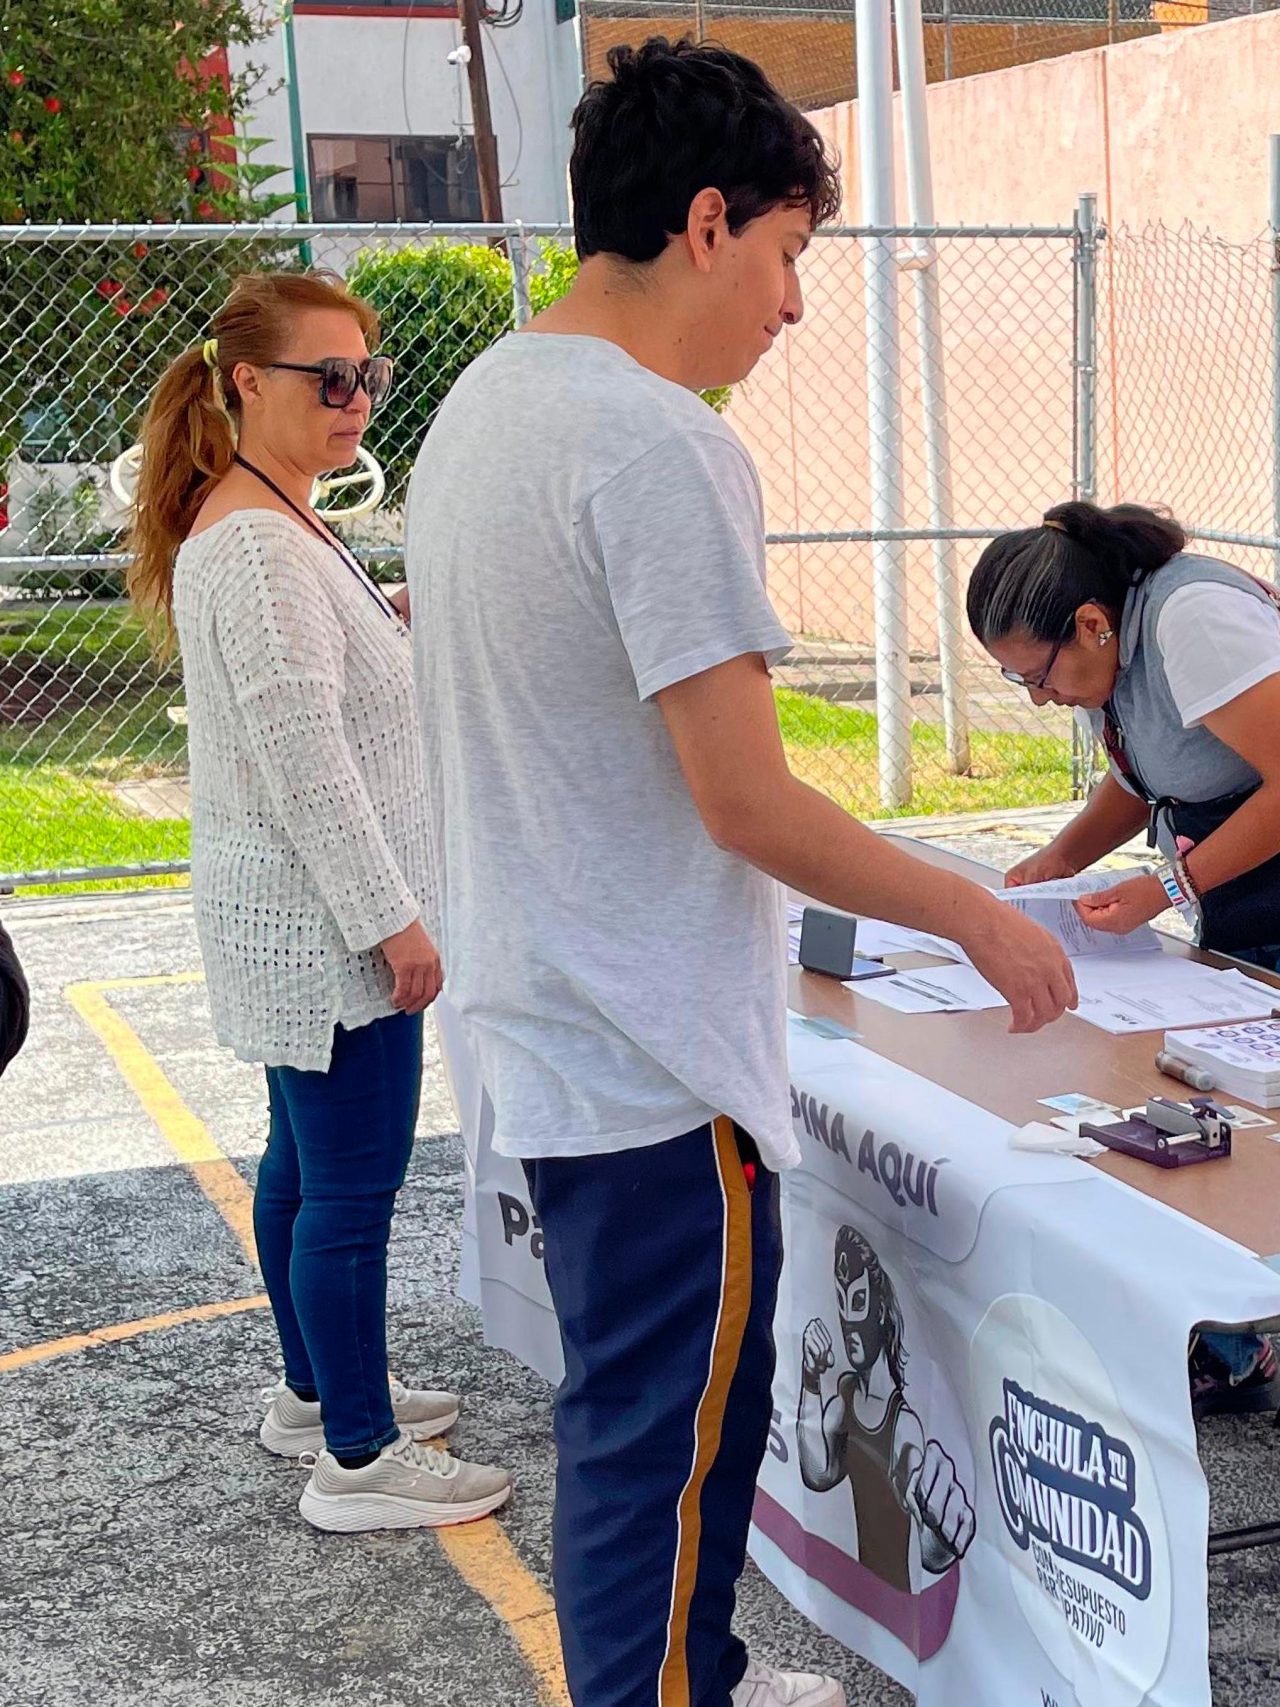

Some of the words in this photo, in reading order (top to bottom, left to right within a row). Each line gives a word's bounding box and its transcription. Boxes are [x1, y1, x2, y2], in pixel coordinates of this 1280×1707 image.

[857, 1128, 953, 1217] AQUÍ
[1006, 1389, 1107, 1489] ENCHULA
[1107, 1448, 1128, 1483] TU
[1031, 1540, 1054, 1575] CON
